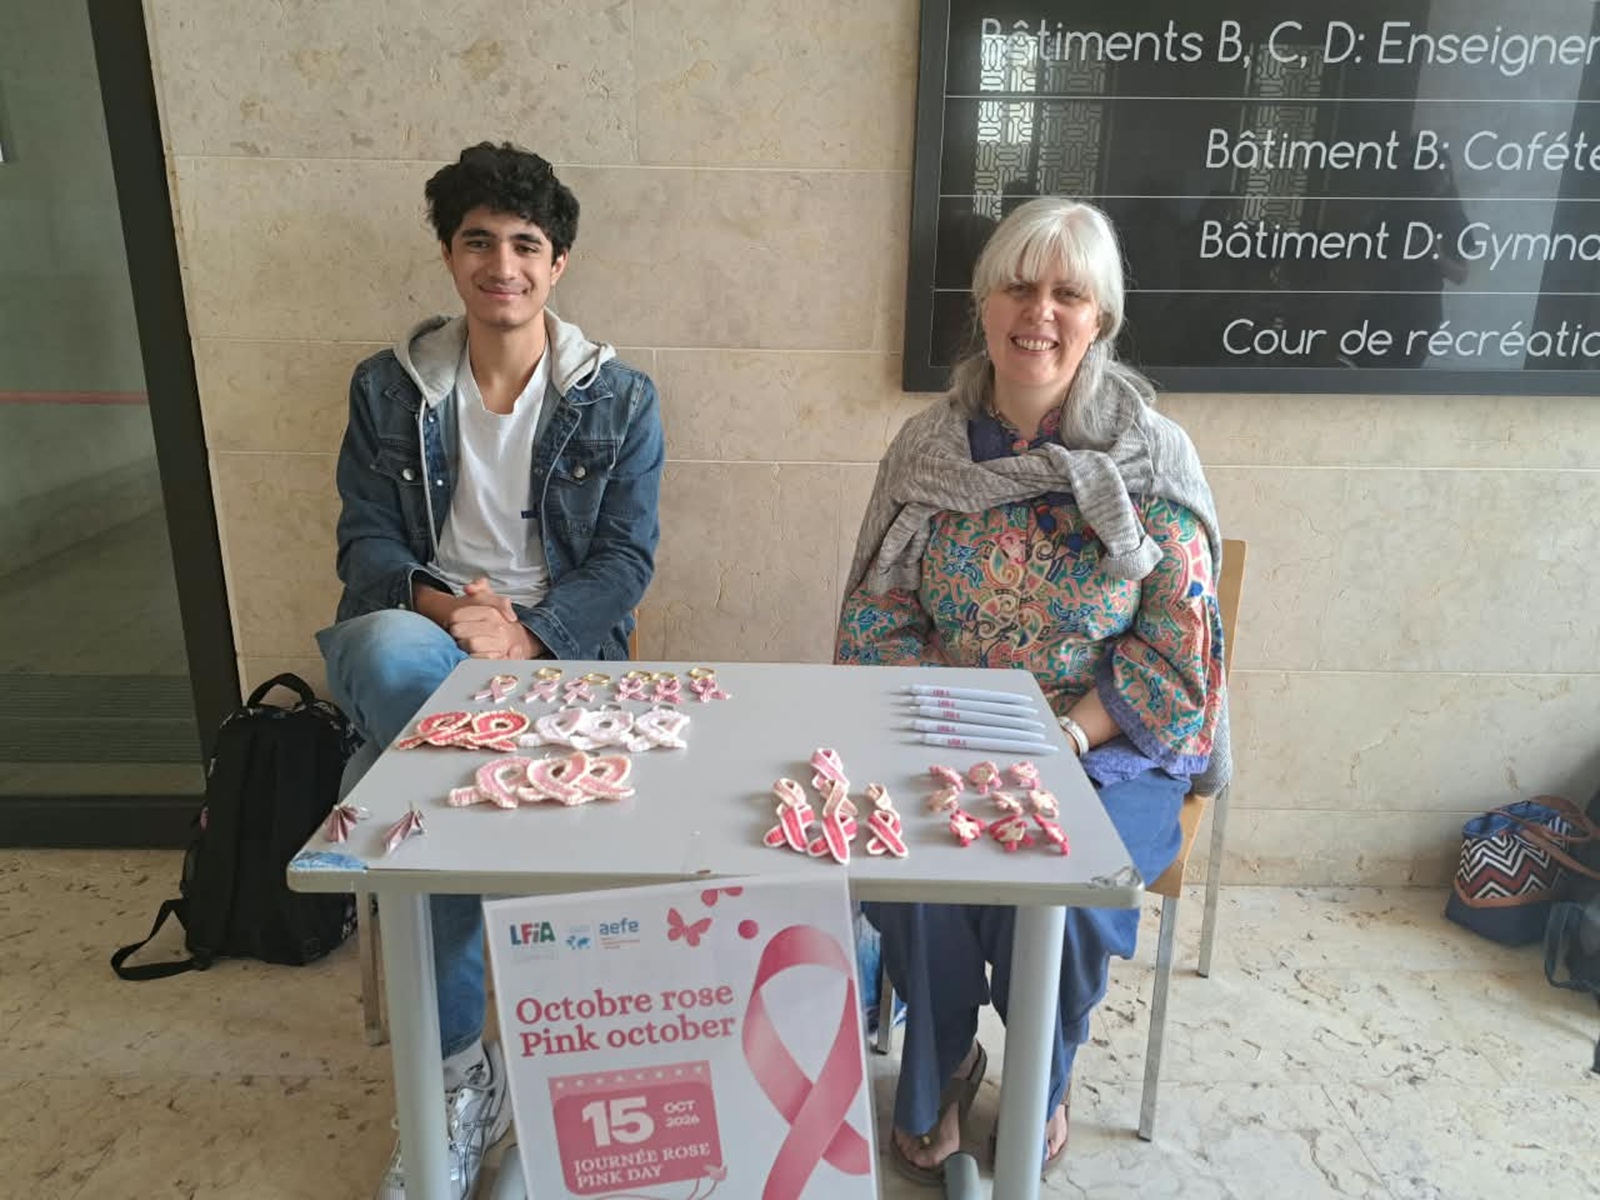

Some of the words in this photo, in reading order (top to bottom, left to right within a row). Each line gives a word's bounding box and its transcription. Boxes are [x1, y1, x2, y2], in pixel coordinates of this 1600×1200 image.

[1217, 20, 1251, 69] B,
[1268, 21, 1309, 69] C,
[1322, 21, 1364, 63] D:
[1205, 129, 1399, 169] Bâtiment
[1412, 131, 1449, 170] B:
[1199, 221, 1388, 259] Bâtiment
[1402, 222, 1443, 260] D:
[1222, 318, 1326, 356] Cour
[1340, 319, 1393, 355] de
[599, 917, 640, 936] aefe
[516, 987, 653, 1025] Octobre
[661, 984, 735, 1010] rose
[519, 1023, 600, 1058] Pink
[606, 1012, 737, 1048] october
[581, 1096, 655, 1148] 15
[664, 1101, 696, 1114] OCT
[573, 1148, 658, 1175] JOURNÉE
[662, 1142, 711, 1162] ROSE
[577, 1171, 624, 1189] PINK
[627, 1165, 663, 1181] DAY
